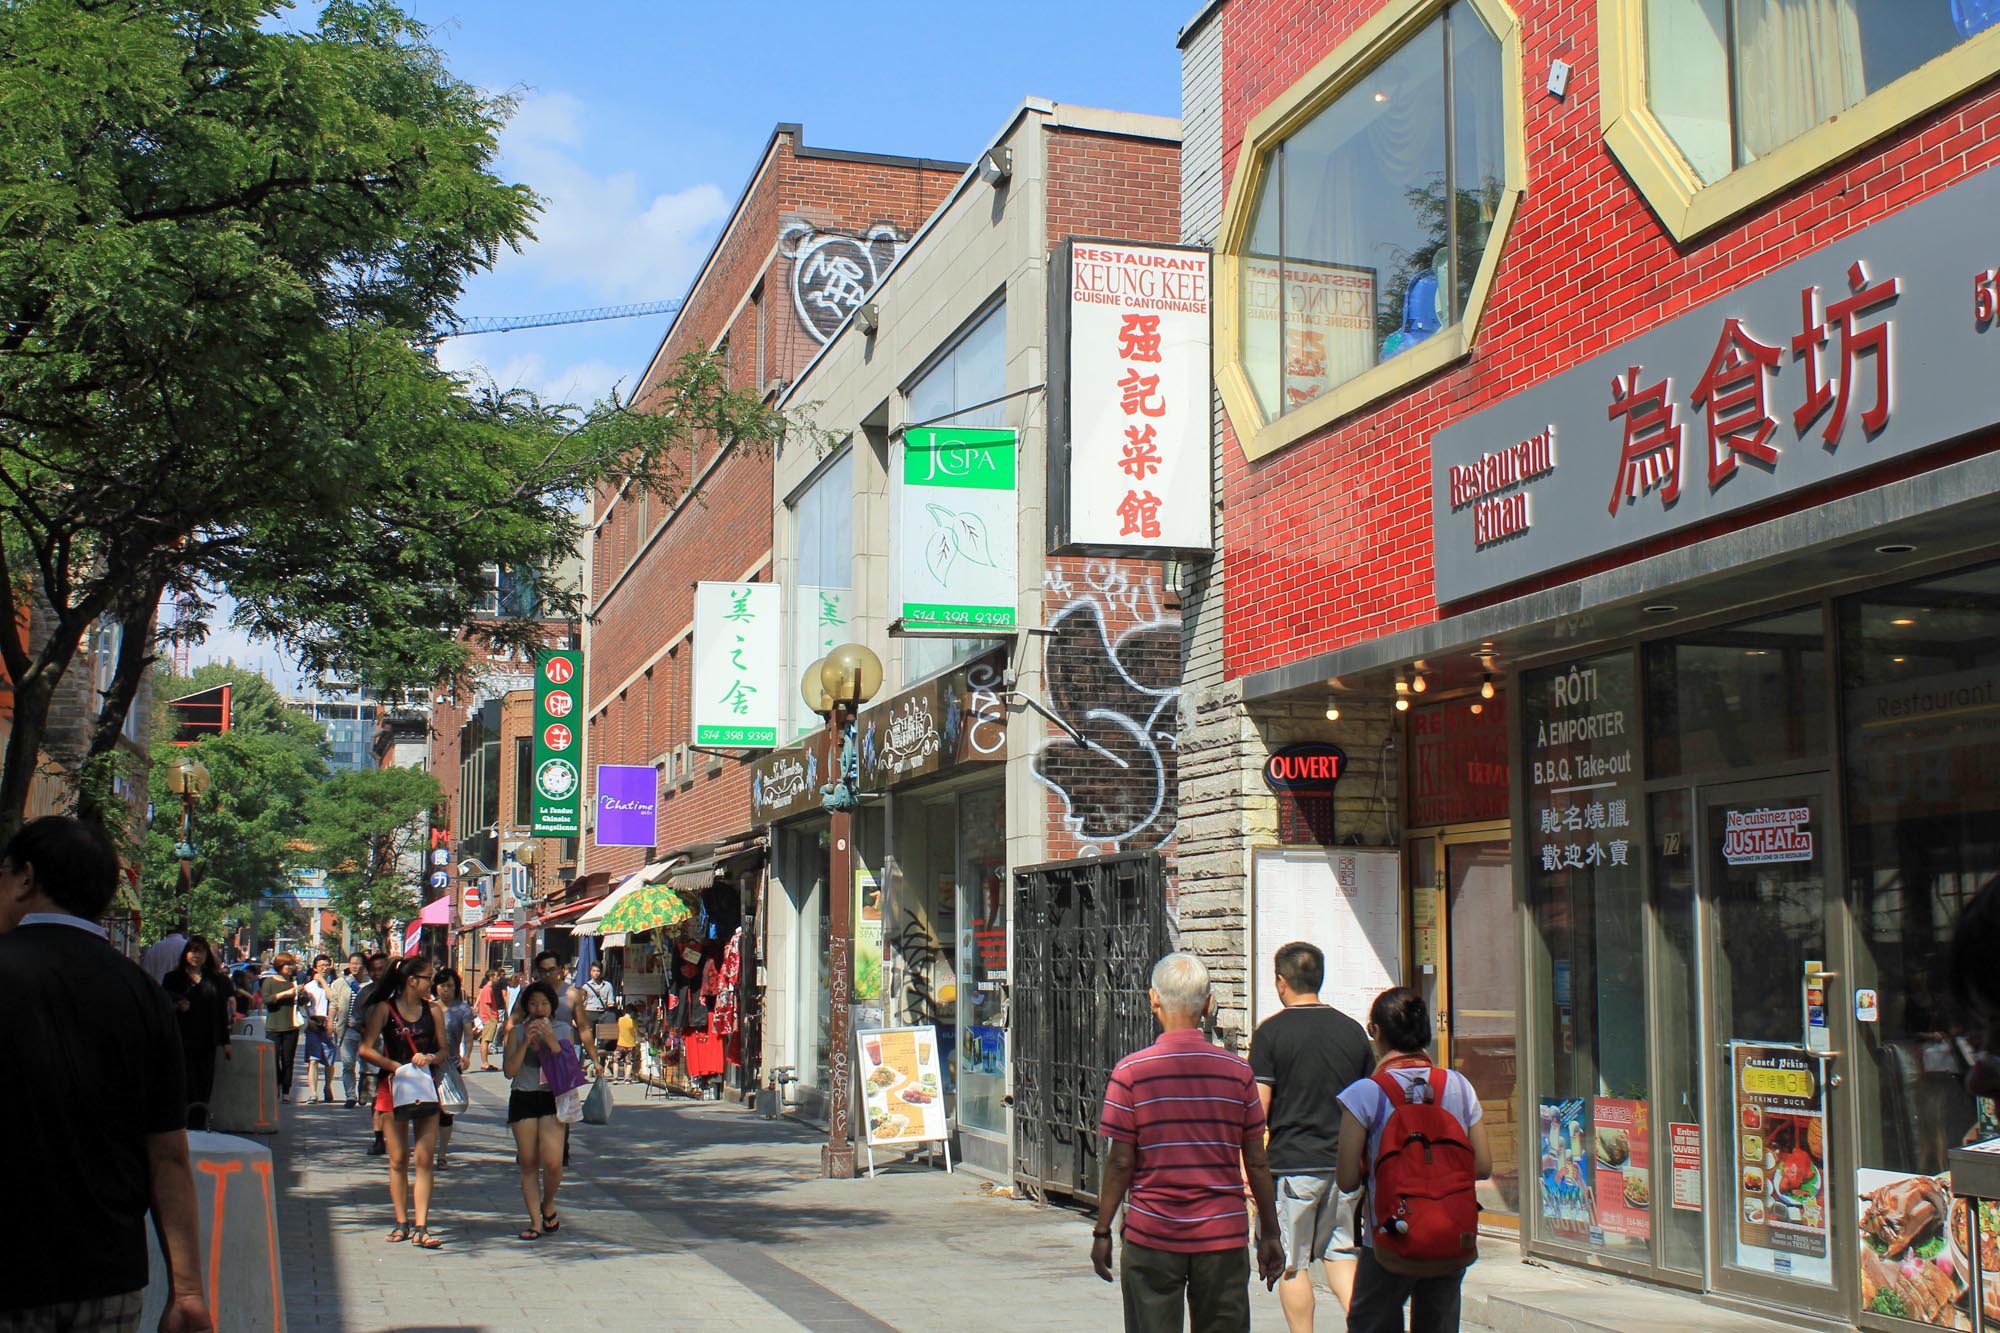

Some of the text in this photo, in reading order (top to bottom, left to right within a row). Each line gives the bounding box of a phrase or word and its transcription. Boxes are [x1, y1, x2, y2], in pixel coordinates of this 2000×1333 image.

[1074, 248, 1206, 272] RESTAURANT
[1074, 262, 1206, 302] KEUNG KEE
[1074, 290, 1207, 314] CUISINE CANTONNAISE
[1608, 260, 1902, 516] 為食坊
[1116, 314, 1166, 539] 强記菜館
[950, 448, 996, 470] SPA
[1450, 425, 1555, 508] Restaurant
[1474, 492, 1530, 545] Ethan
[913, 610, 1010, 626] 514 398 9398
[718, 588, 757, 715] 美之舍
[1554, 665, 1598, 708] RÔTI
[548, 662, 573, 751] 小肥羊
[701, 729, 774, 741] 514 398 9398
[1538, 711, 1624, 748] À EMPORTER
[1270, 756, 1339, 779] OUVERT
[1534, 749, 1631, 784] B.B.Q. Take-out
[605, 799, 654, 811] Chatime
[1728, 809, 1807, 826] Ne cuisinez pas
[1541, 839, 1630, 871] 歡迎外賣
[1665, 835, 1679, 853] 72
